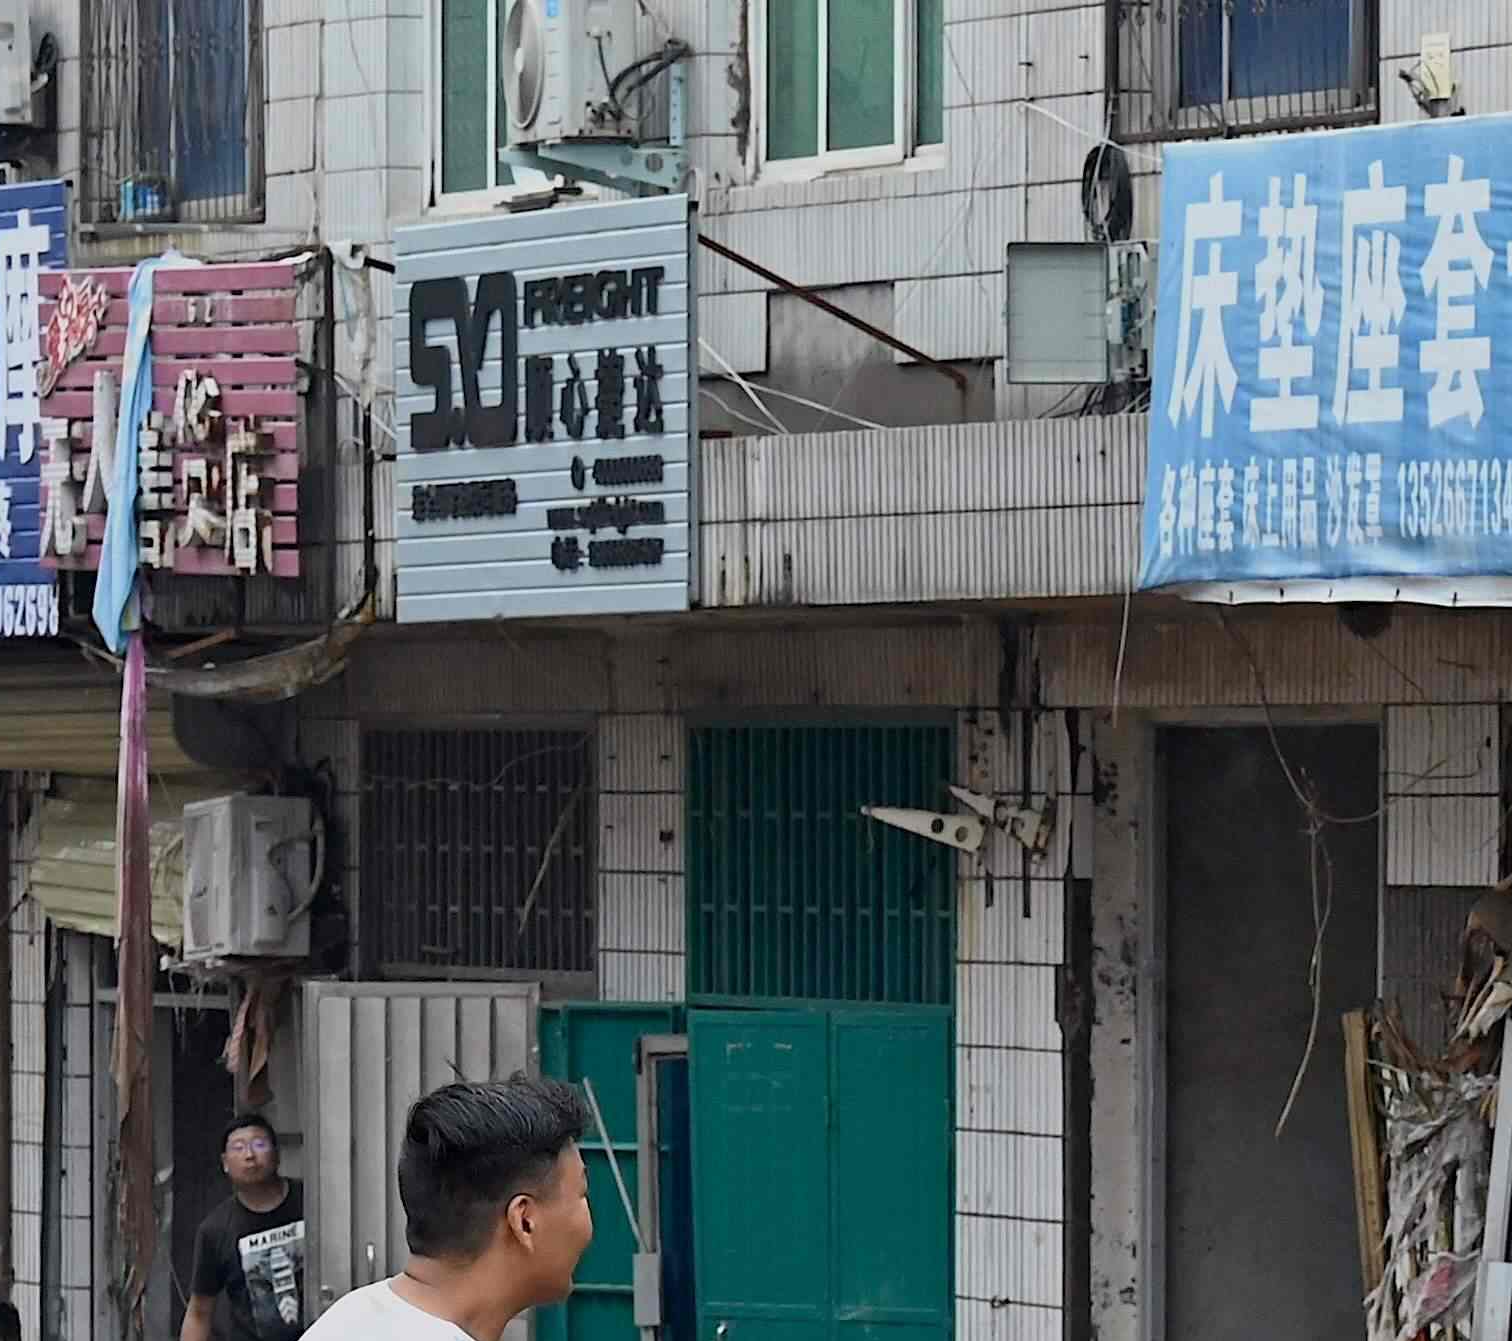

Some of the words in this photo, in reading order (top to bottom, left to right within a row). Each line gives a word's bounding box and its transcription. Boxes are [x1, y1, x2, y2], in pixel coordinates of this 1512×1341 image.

[524, 266, 665, 330] FREIGHT
[1159, 458, 1235, 561] 各种座套
[1242, 454, 1319, 552] 床上用品
